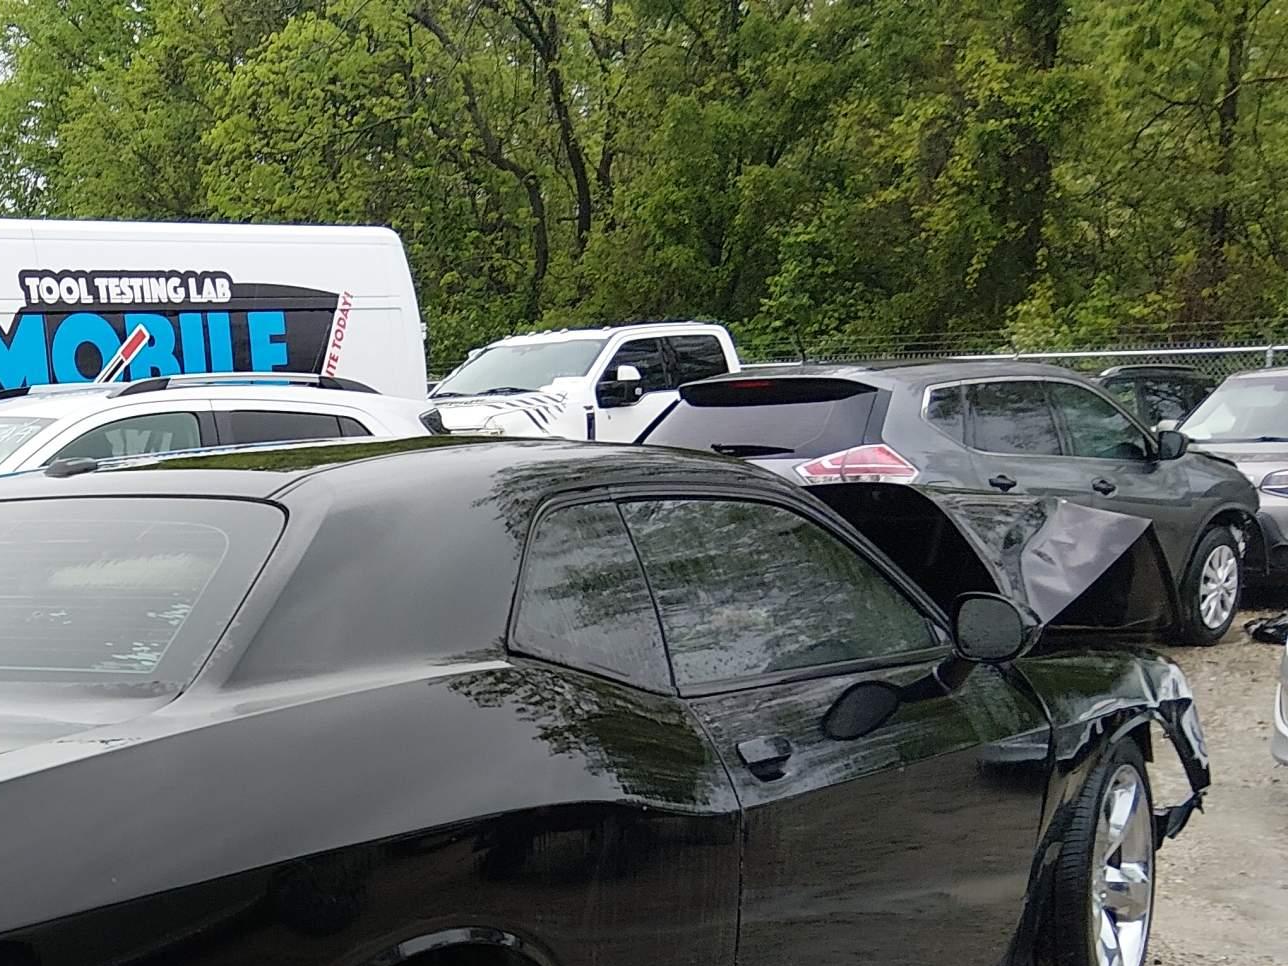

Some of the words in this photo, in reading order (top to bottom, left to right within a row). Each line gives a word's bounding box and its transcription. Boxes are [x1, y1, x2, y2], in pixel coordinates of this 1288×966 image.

[25, 277, 93, 304] TOOL
[94, 277, 185, 304] TESTING
[188, 277, 231, 304] LAB
[331, 291, 353, 350] TODAY!
